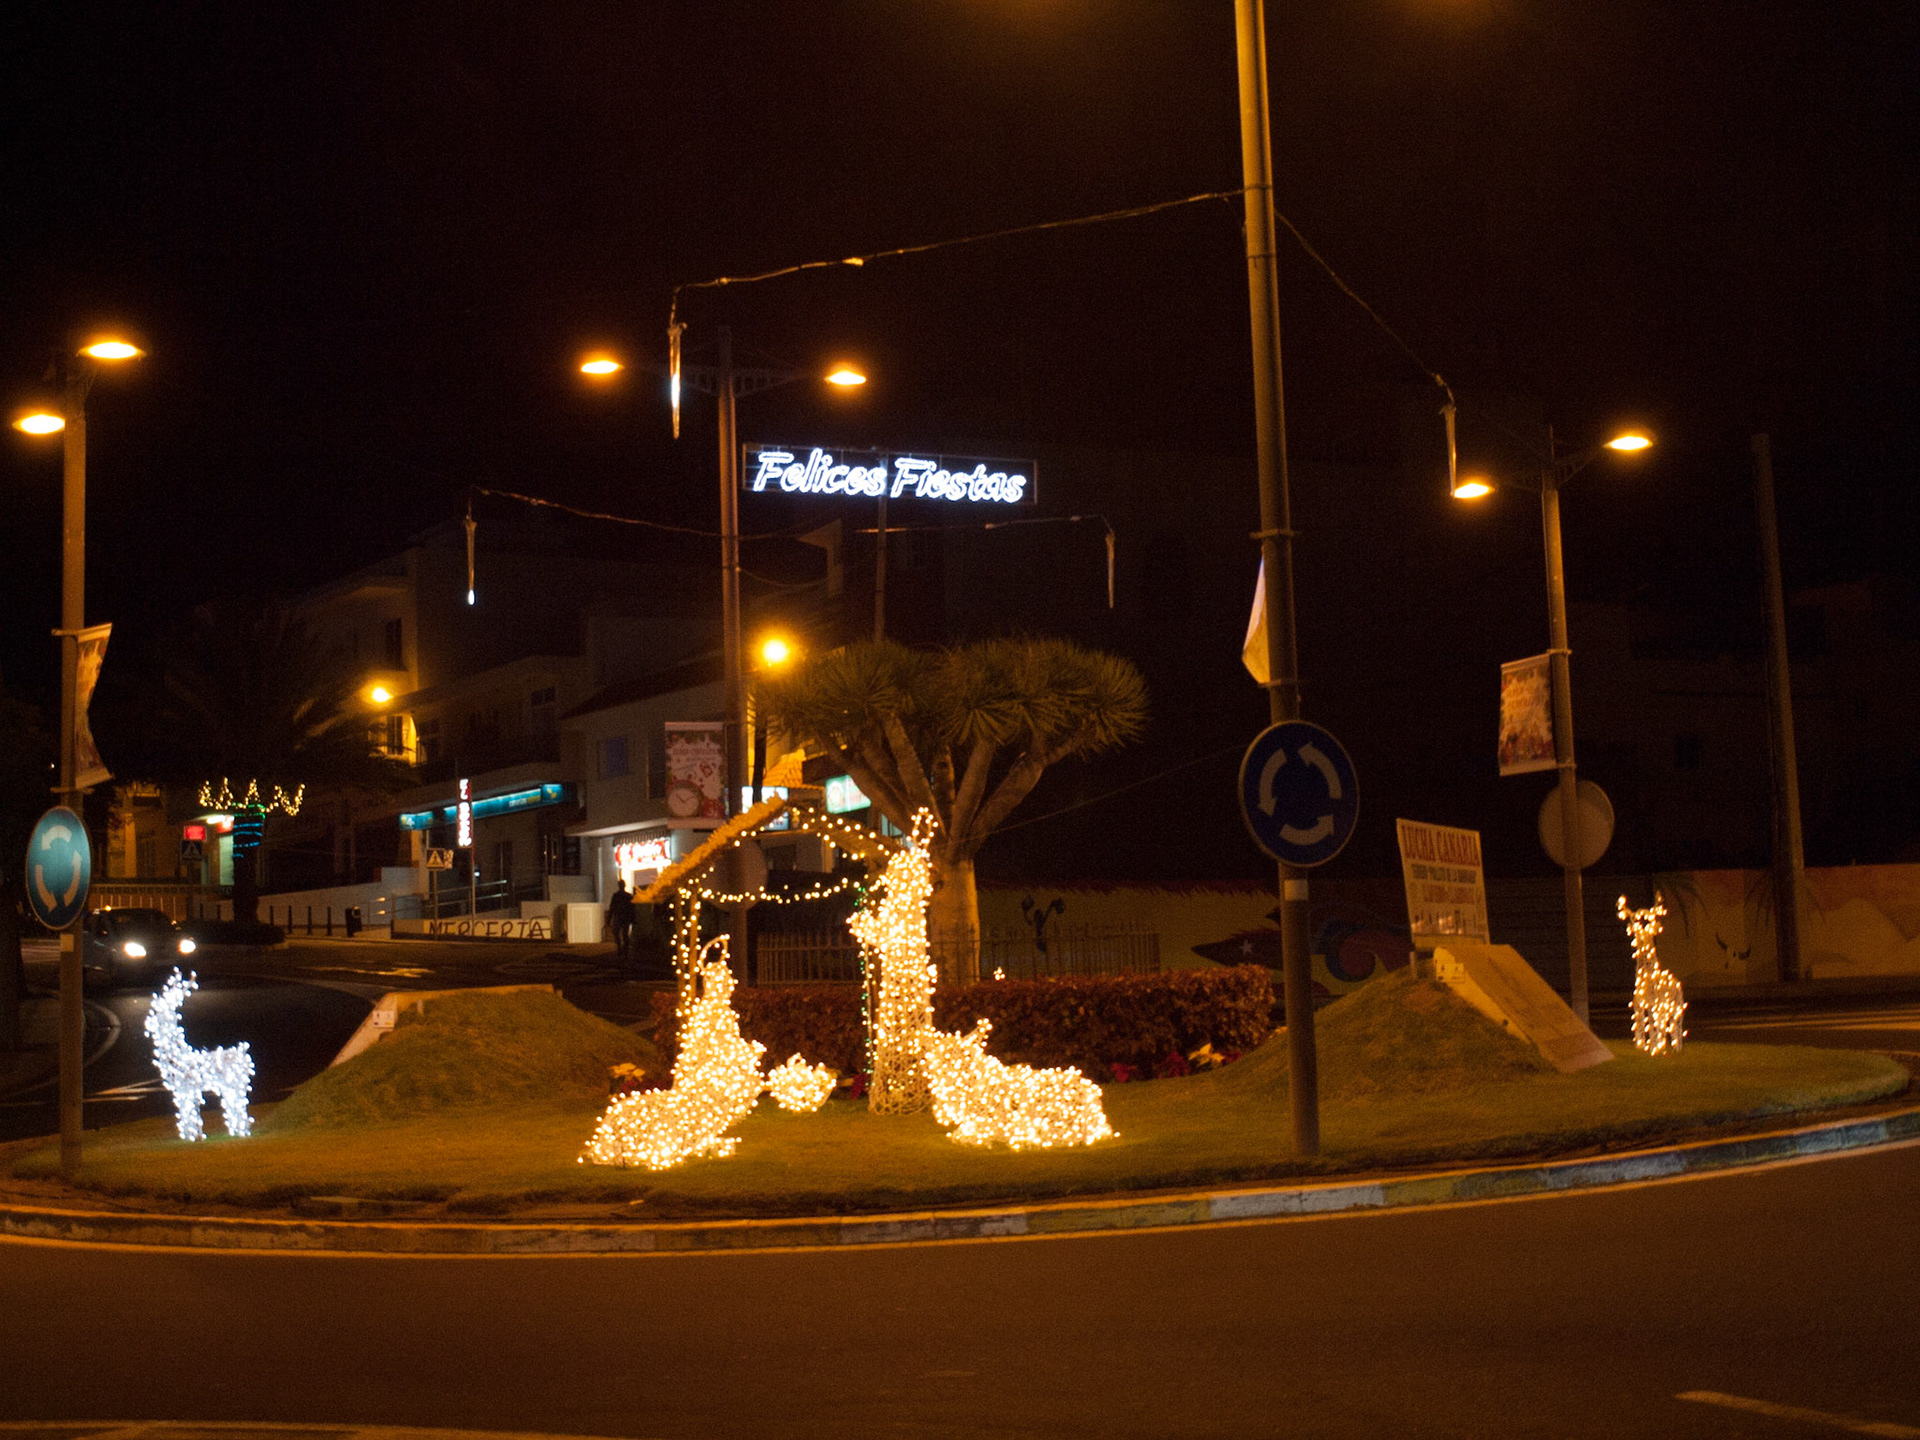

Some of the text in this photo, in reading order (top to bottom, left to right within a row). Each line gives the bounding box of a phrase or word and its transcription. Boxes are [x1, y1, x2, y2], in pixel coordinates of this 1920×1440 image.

[753, 448, 1027, 503] Felices Fiestas
[1402, 825, 1480, 867] LUCHA CANARIA
